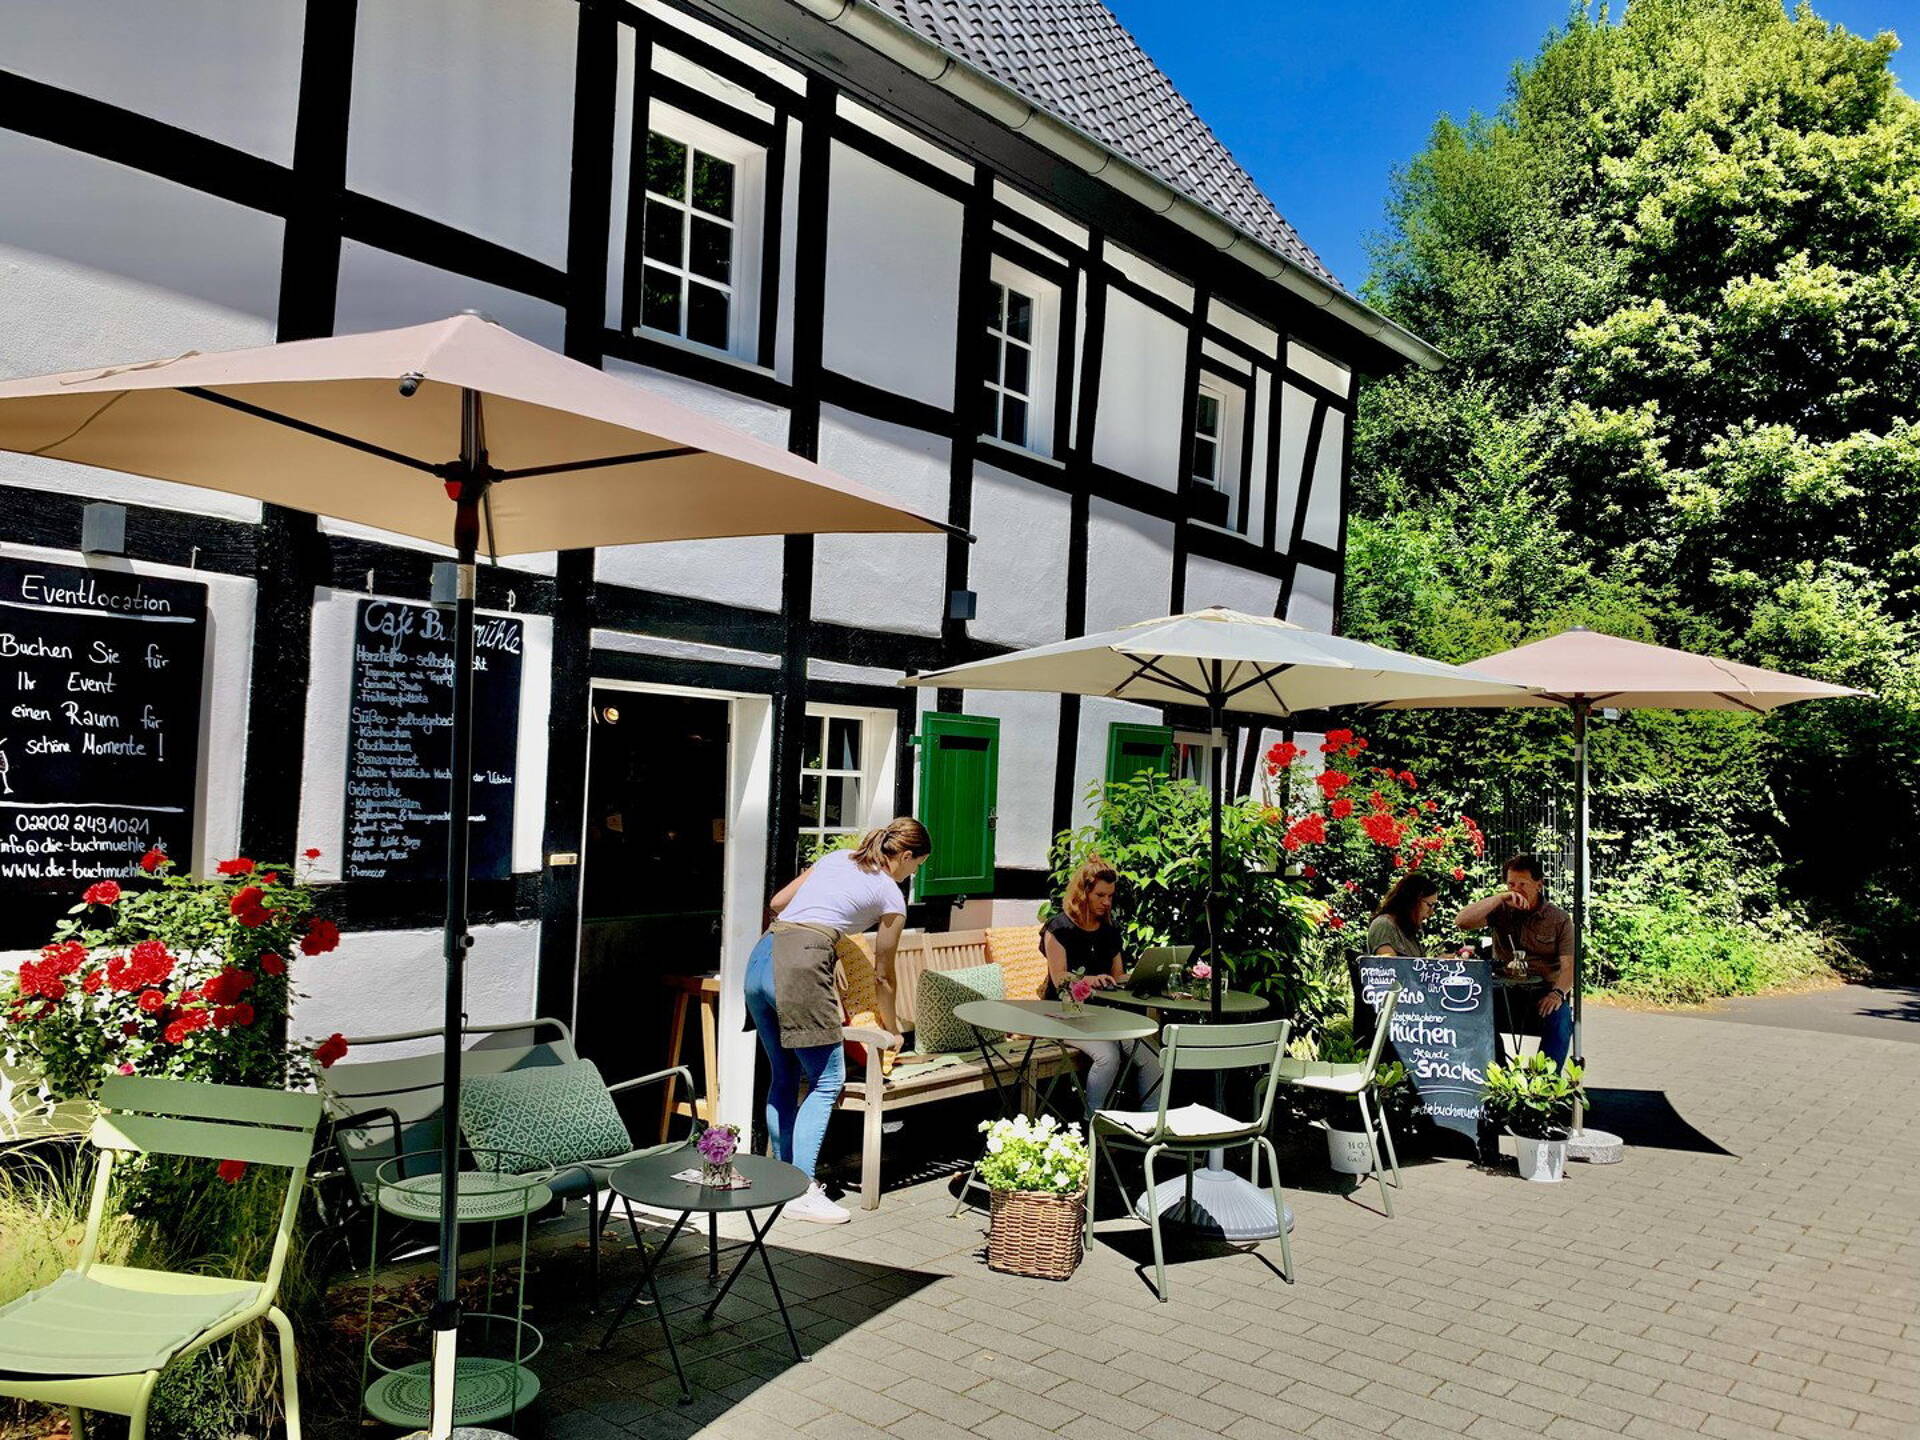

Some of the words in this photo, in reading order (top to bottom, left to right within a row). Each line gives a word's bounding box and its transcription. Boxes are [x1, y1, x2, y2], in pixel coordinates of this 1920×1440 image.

[21, 574, 171, 612] Eventlocation
[364, 600, 414, 651] Café
[419, 608, 521, 655] Bumühle
[0, 633, 72, 660] Buchen
[89, 641, 120, 664] Sie
[145, 643, 170, 669] für
[18, 671, 36, 690] Ihr
[67, 671, 117, 694] Event
[12, 704, 51, 721] einen
[60, 701, 119, 728] Raum
[140, 704, 163, 729] für
[351, 707, 388, 727] Süßes
[25, 735, 71, 754] schöne
[82, 732, 147, 755] Momente
[347, 780, 402, 798] Getränke
[15, 814, 69, 832] 02202
[74, 815, 149, 834] 2491021
[1360, 965, 1398, 984] premium
[1389, 1019, 1458, 1048] Kuchen
[1414, 1059, 1485, 1084] Snacks
